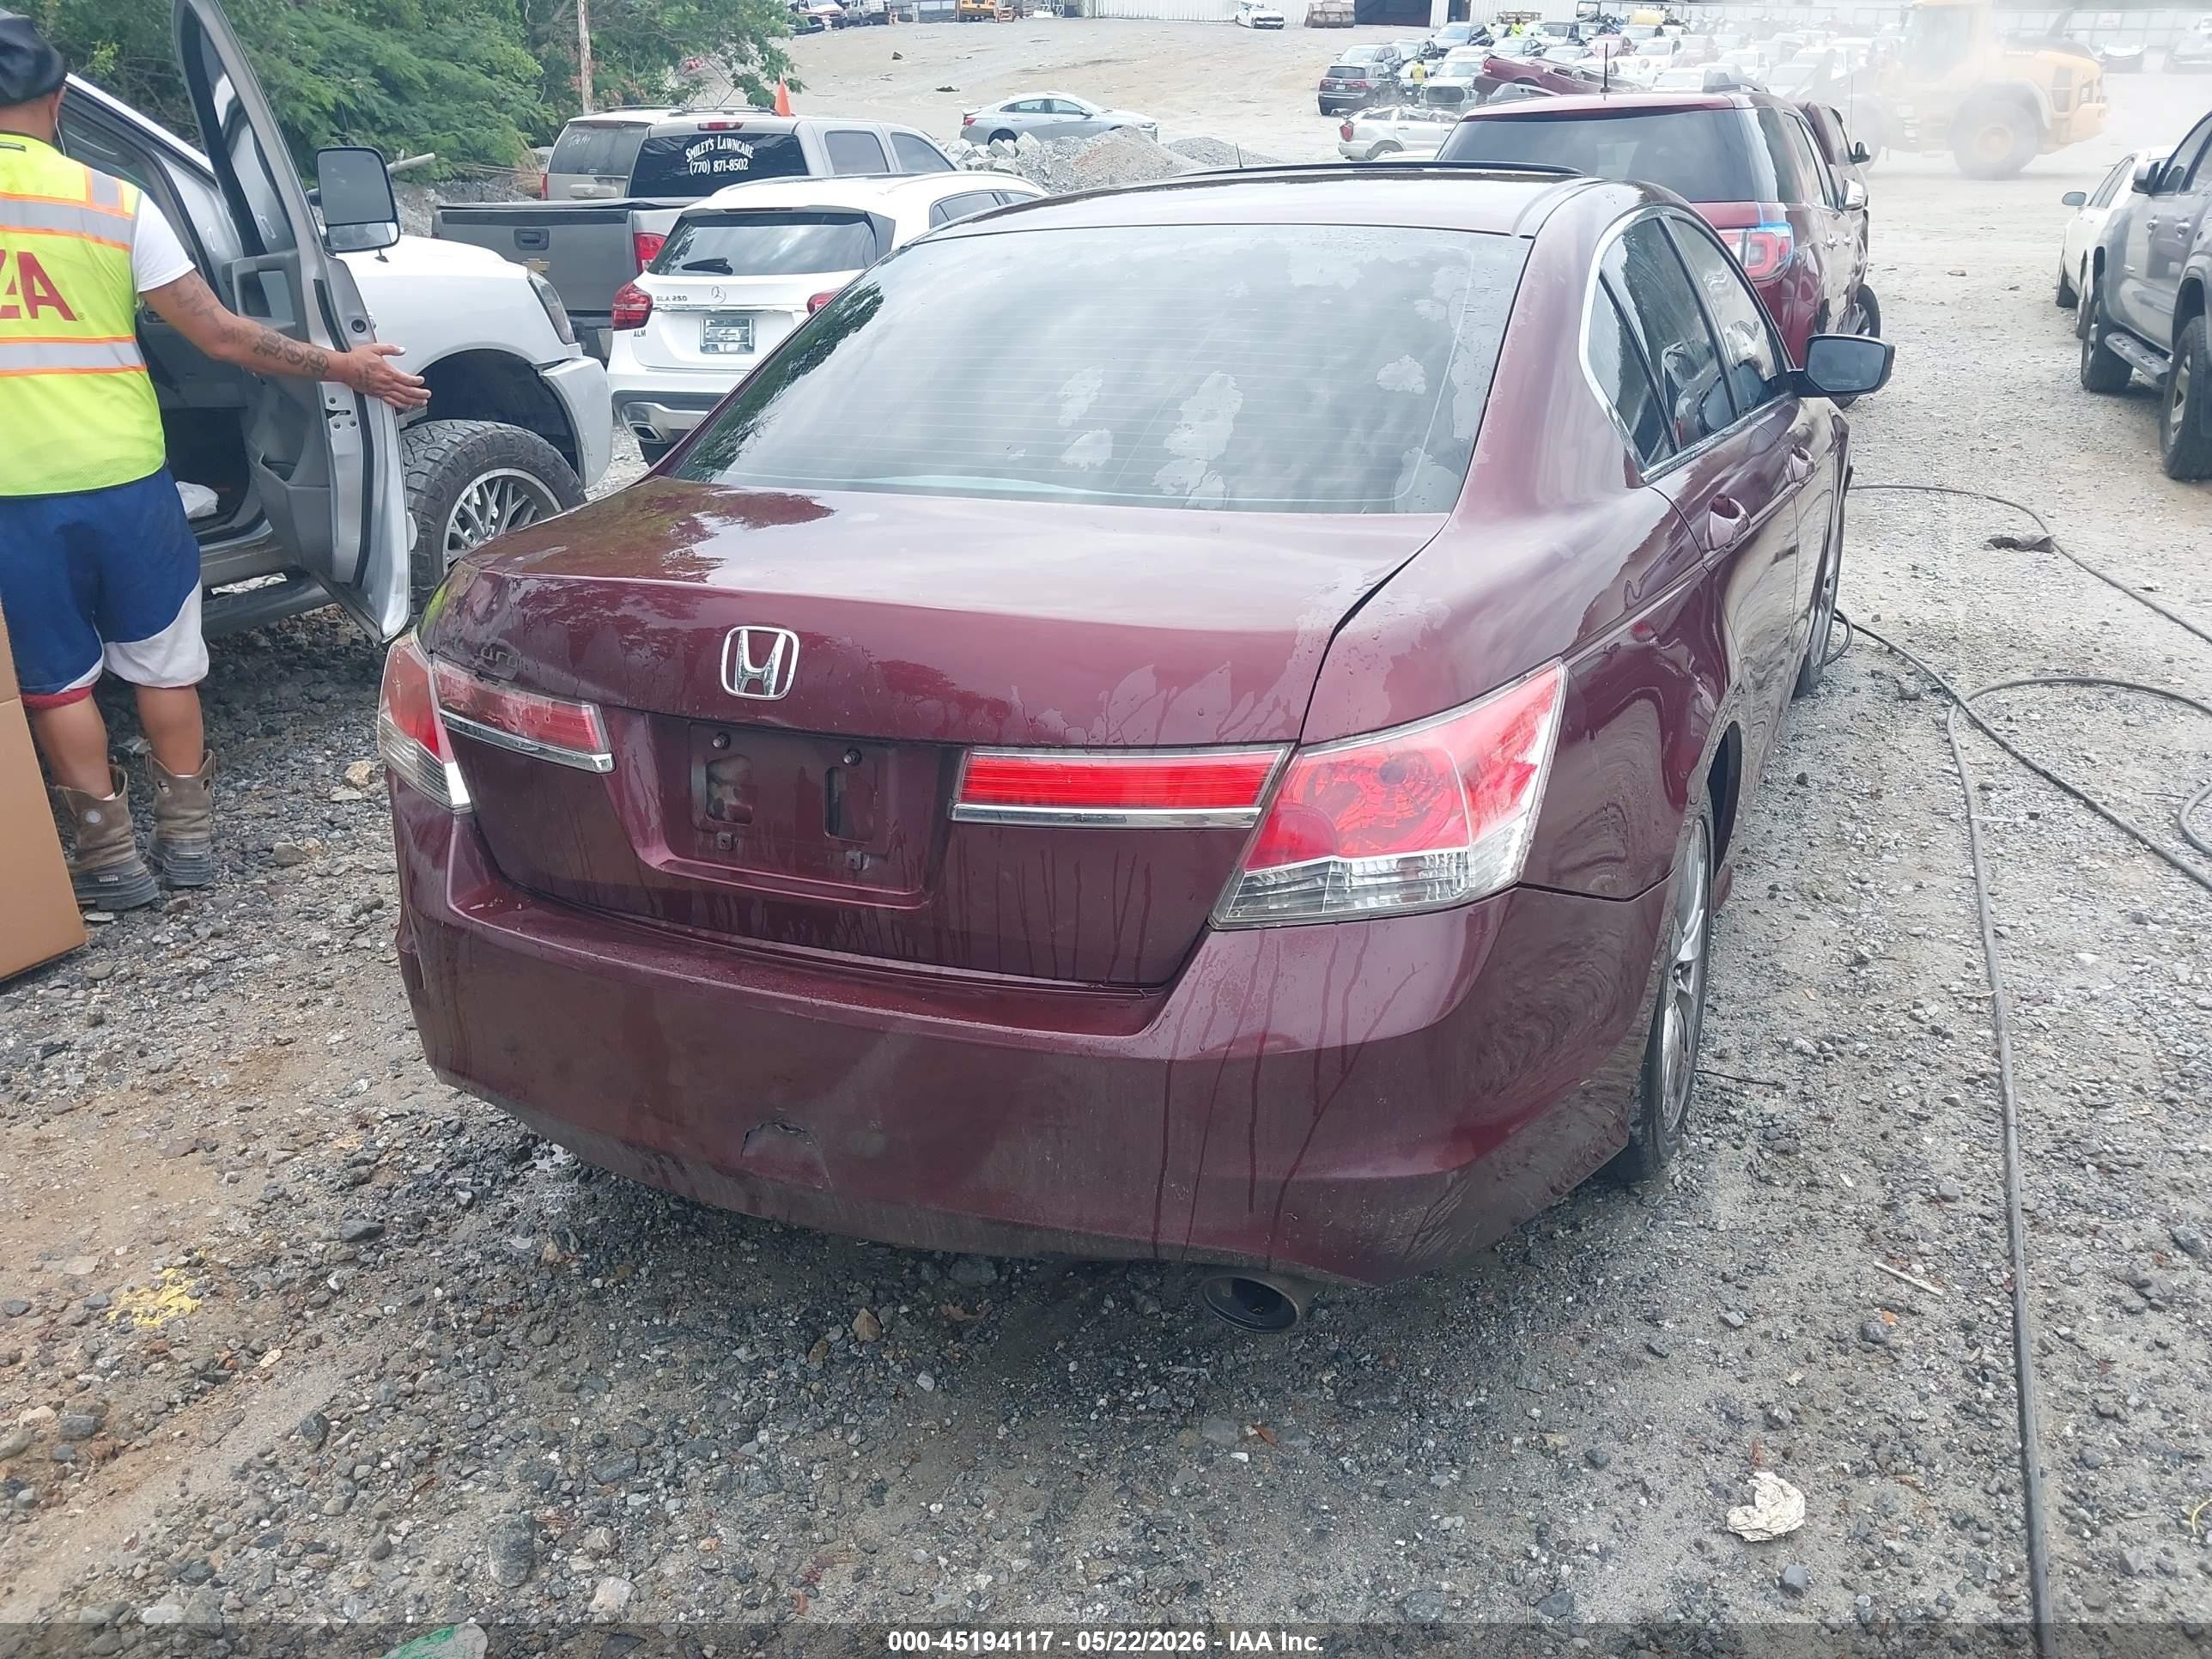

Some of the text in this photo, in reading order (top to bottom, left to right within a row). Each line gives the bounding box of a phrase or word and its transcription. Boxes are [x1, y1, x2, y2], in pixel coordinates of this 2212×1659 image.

[685, 135, 754, 163] SMILEY'S LAWNCARE
[690, 158, 749, 175] (770) 871-8502
